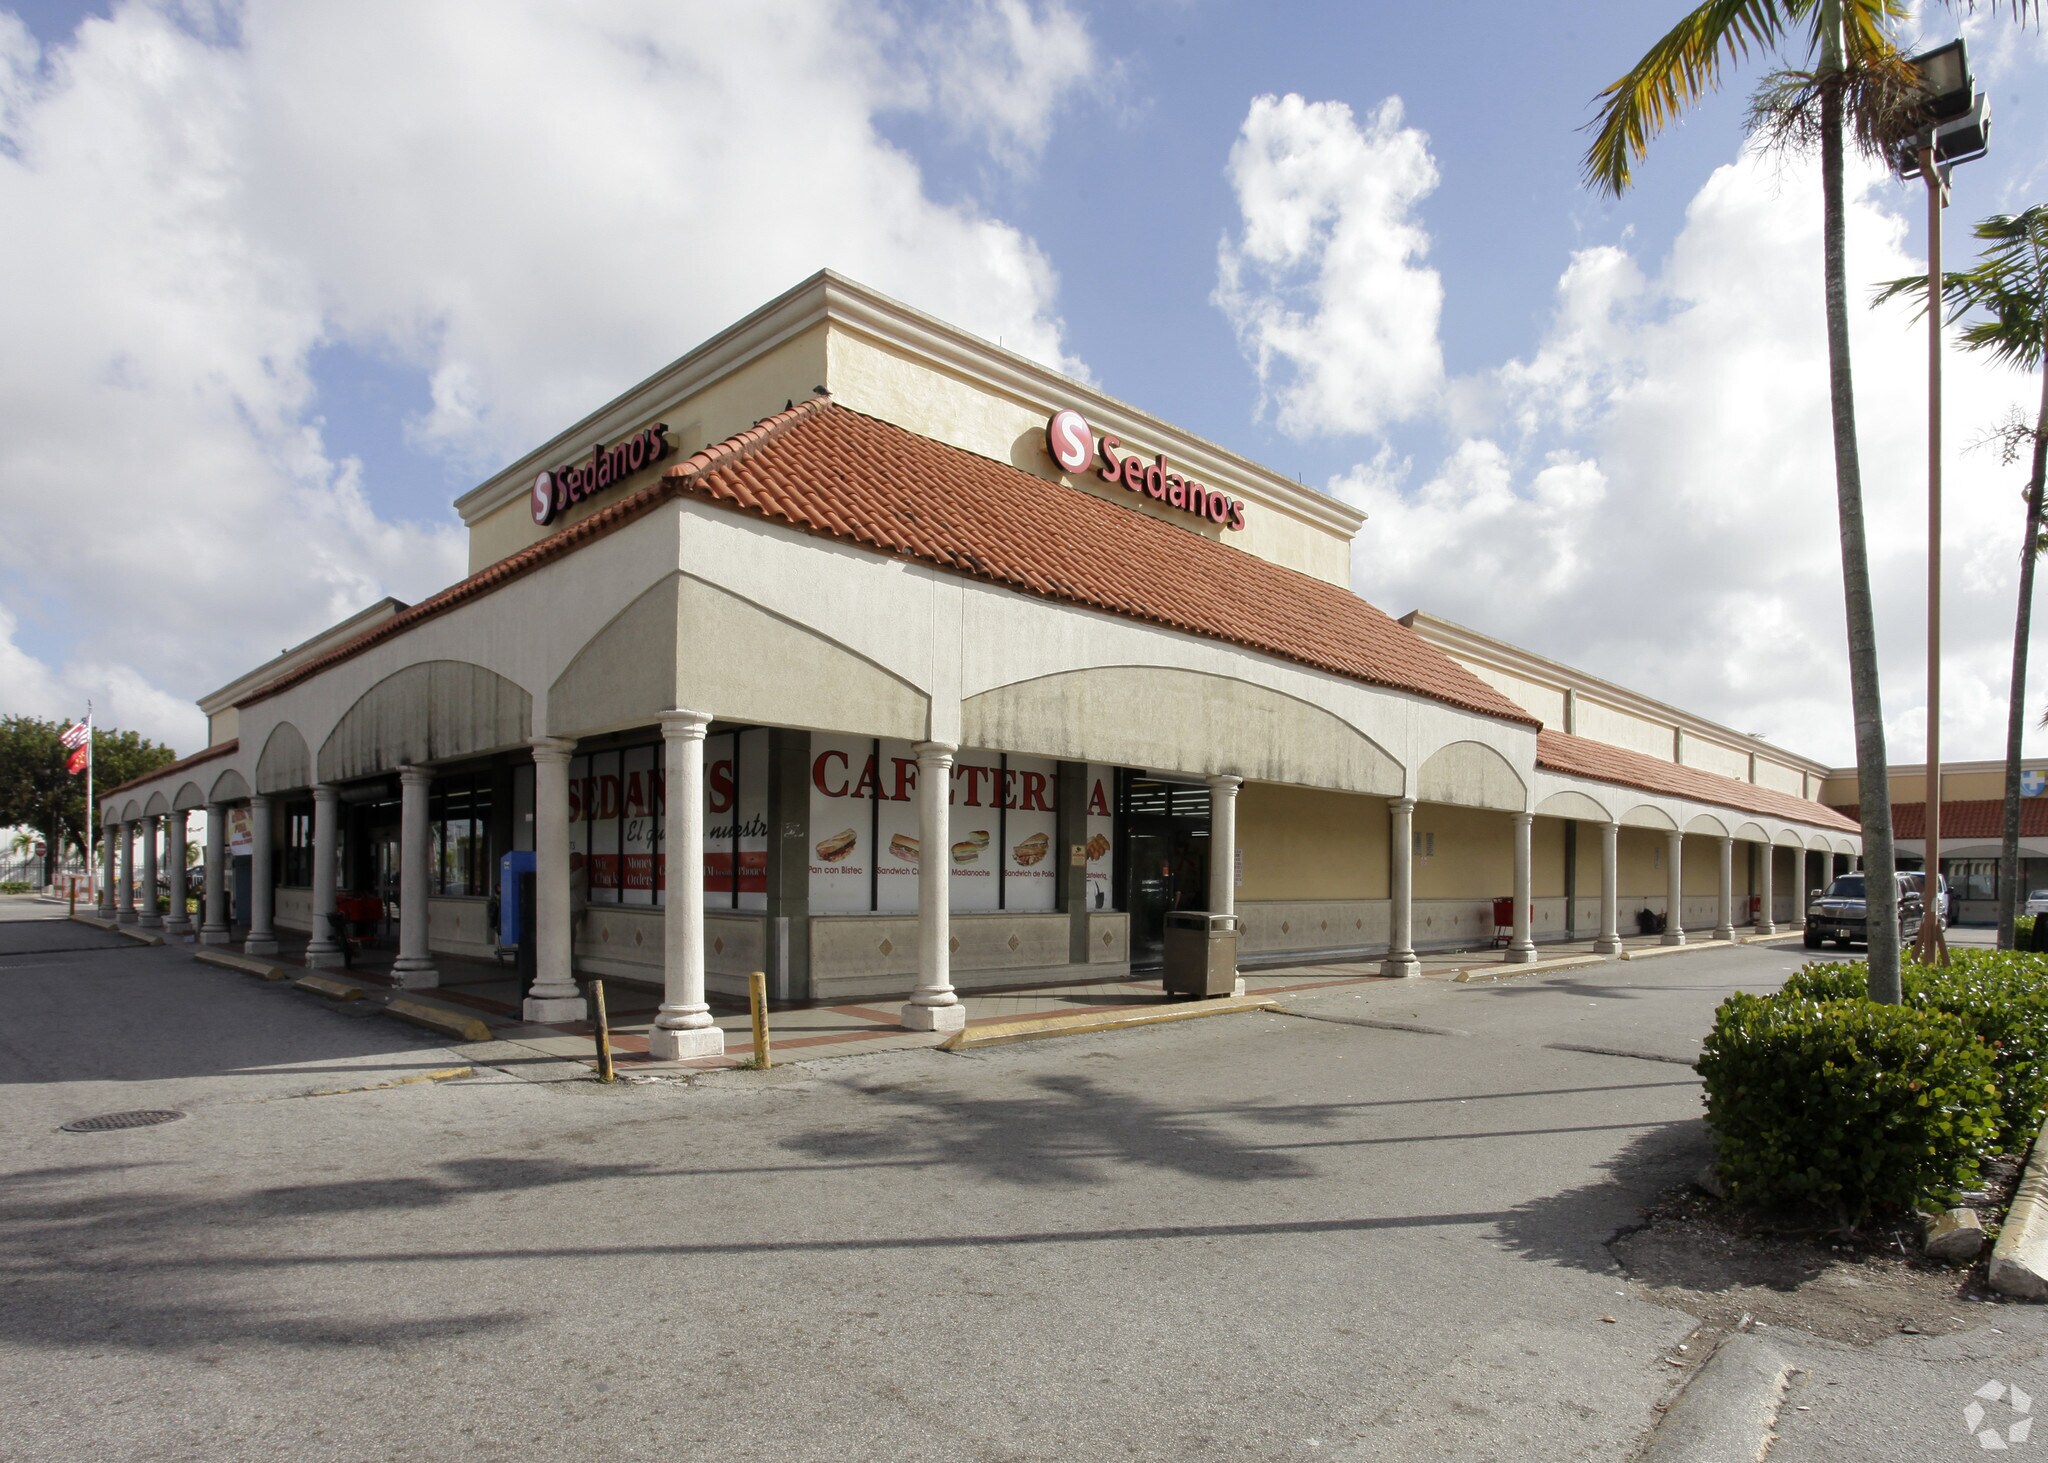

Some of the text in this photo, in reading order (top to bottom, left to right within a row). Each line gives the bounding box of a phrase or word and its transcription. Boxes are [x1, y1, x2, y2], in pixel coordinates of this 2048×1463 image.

[556, 422, 667, 511] Sedano's
[1061, 411, 1245, 531] S Sedano's
[569, 759, 734, 822] SEDANS
[812, 750, 1111, 817] CAFTERA
[627, 819, 644, 842] El
[646, 829, 666, 849] qu
[710, 813, 768, 839] nuestr
[627, 857, 653, 871] Money
[808, 866, 822, 874] Pan
[841, 866, 863, 874] Bistec
[877, 866, 910, 875] Sandwich
[1004, 869, 1032, 877] Sandwich
[627, 873, 653, 886] Orders
